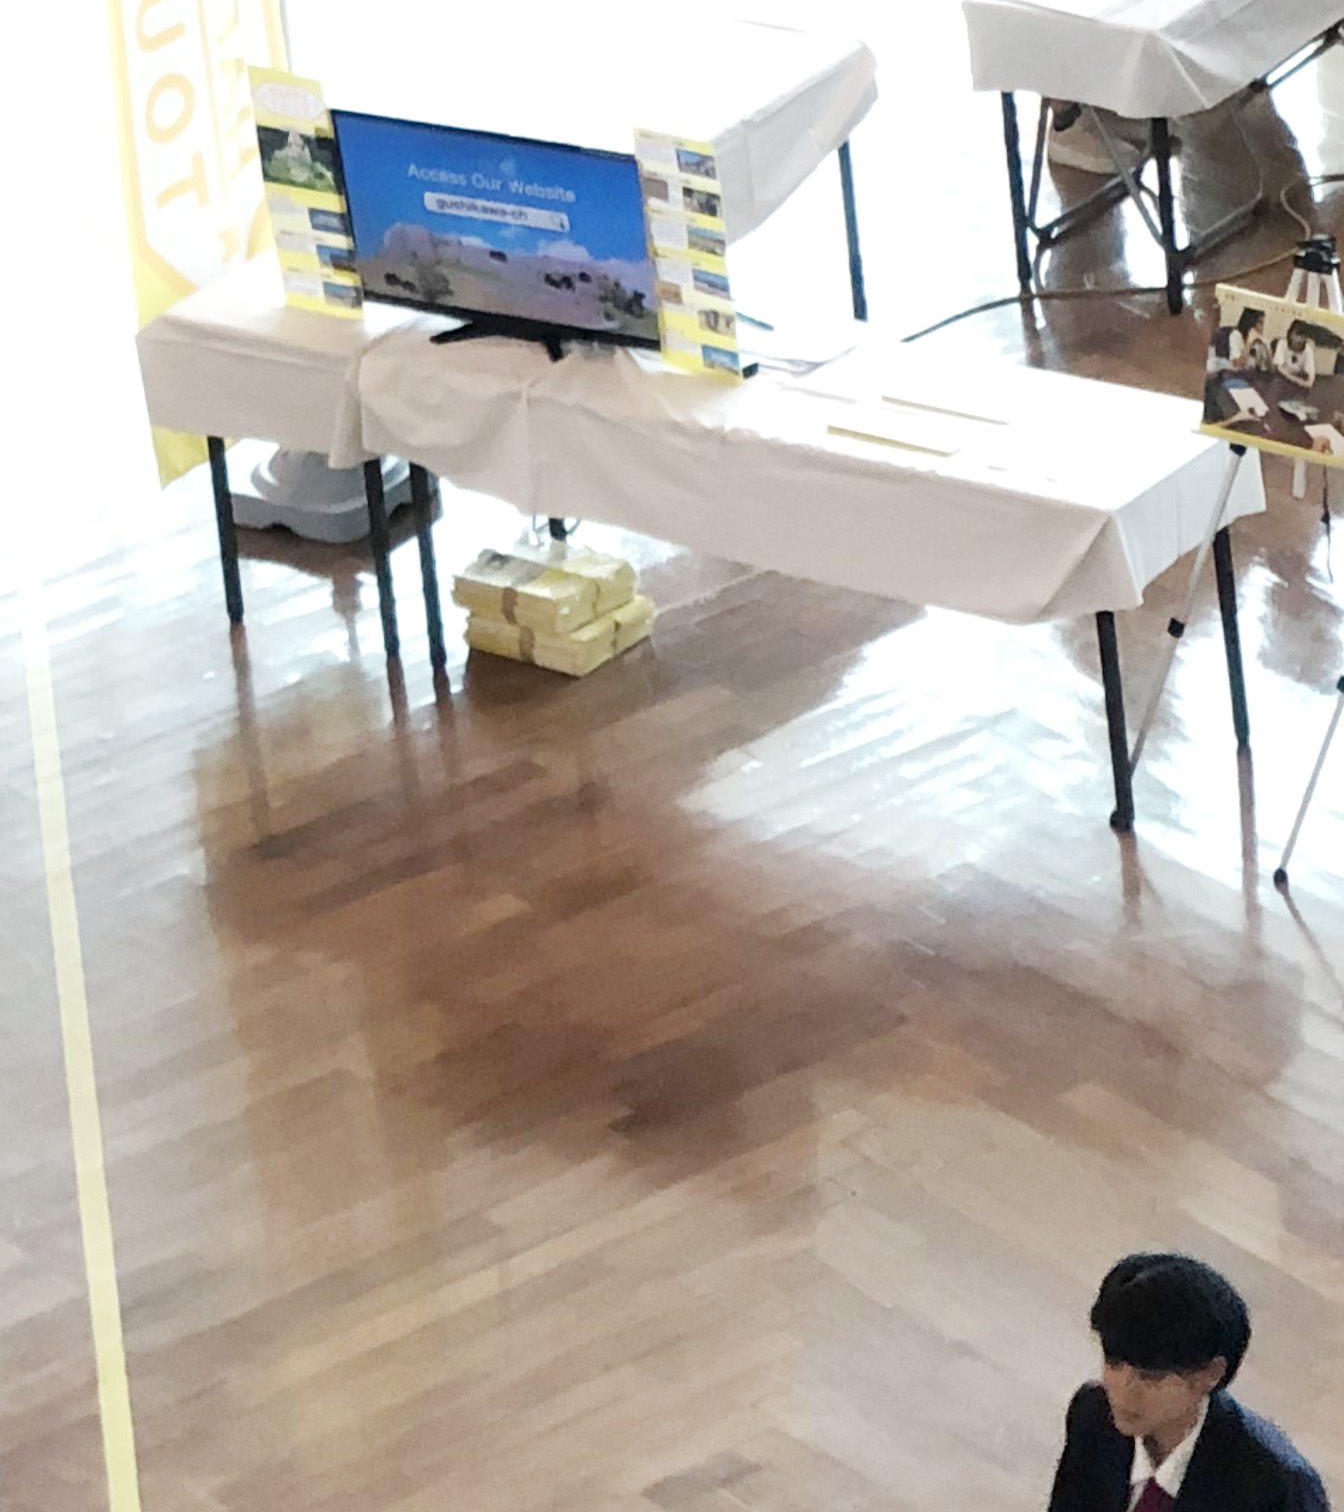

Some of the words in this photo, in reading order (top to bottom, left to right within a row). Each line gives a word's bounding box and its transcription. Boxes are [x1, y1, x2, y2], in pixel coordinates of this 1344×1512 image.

[407, 163, 467, 187] Access
[471, 172, 503, 191] Our
[508, 178, 577, 204] Website
